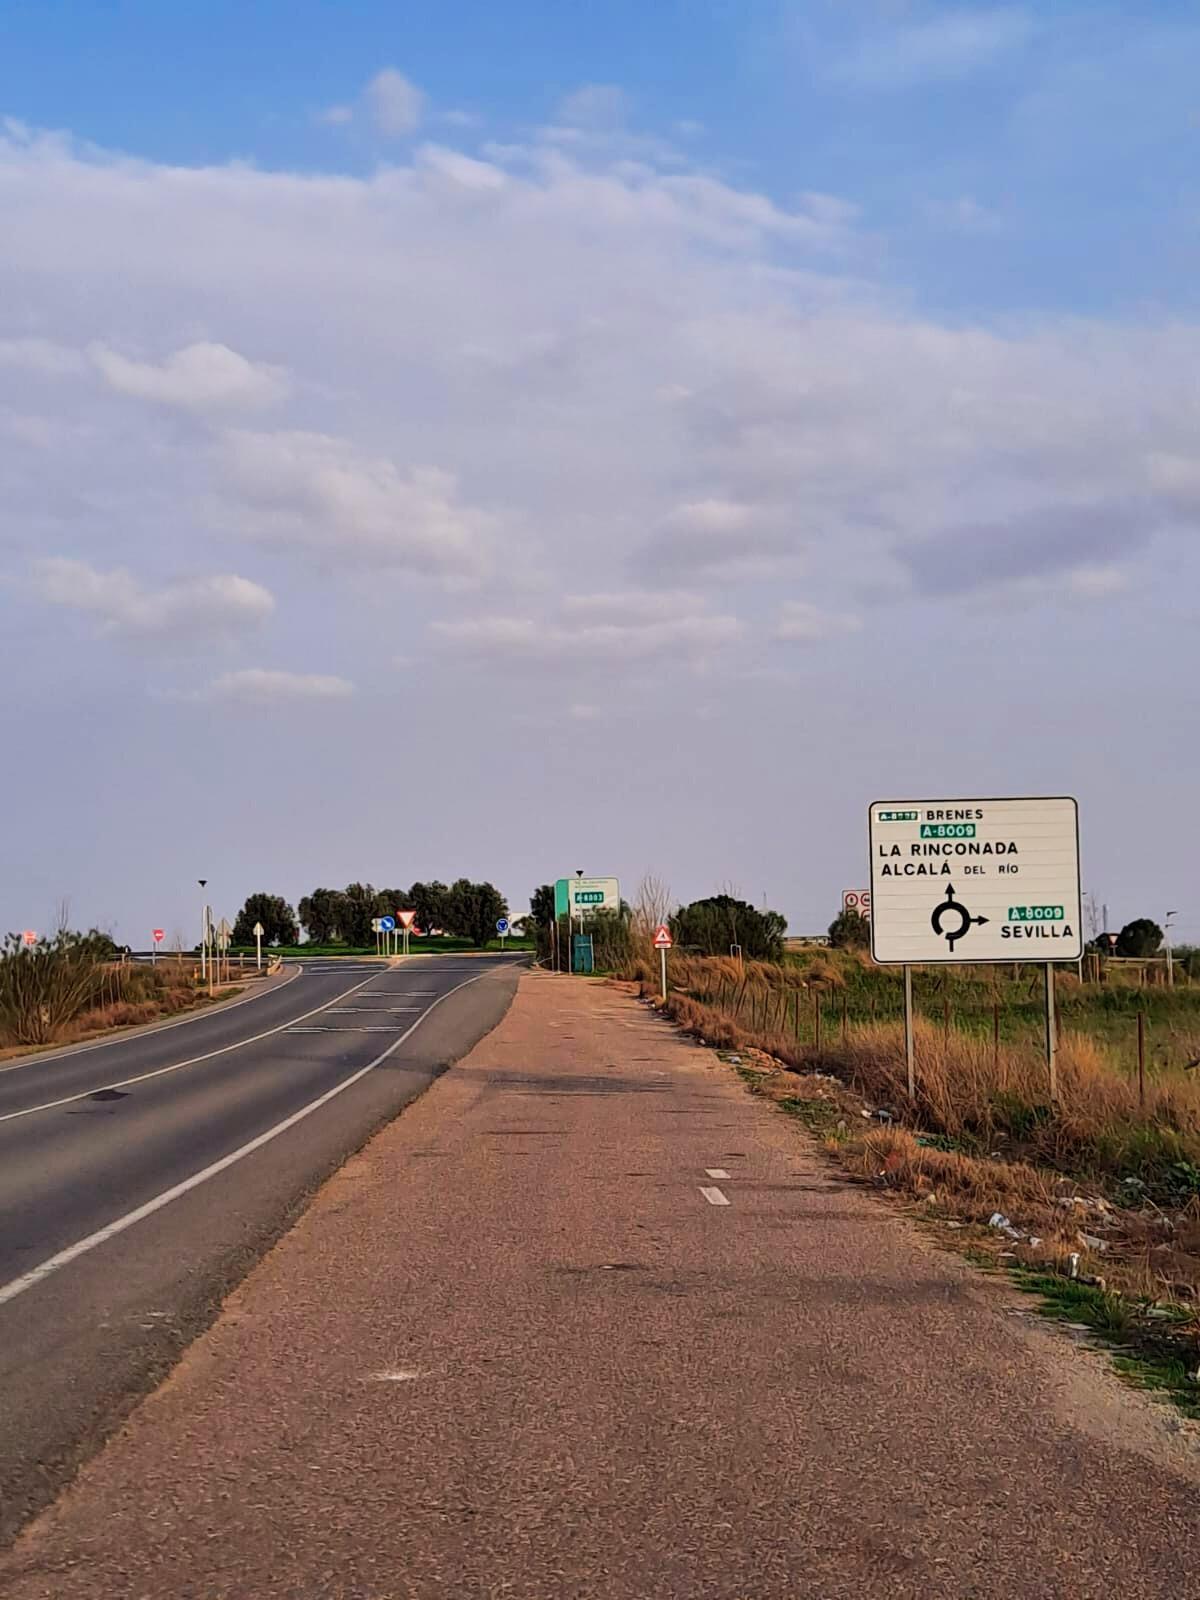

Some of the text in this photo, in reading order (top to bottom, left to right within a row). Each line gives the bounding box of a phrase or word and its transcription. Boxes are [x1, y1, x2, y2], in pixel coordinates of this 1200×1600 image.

[926, 809, 984, 821] BRENES
[923, 825, 975, 837] A-8009
[879, 842, 1019, 857] LA RINCONADA
[881, 859, 1019, 876] ALCALÁ DEL RÍO
[1010, 907, 1063, 920] A-8009
[1000, 924, 1074, 938] SEVILLA
